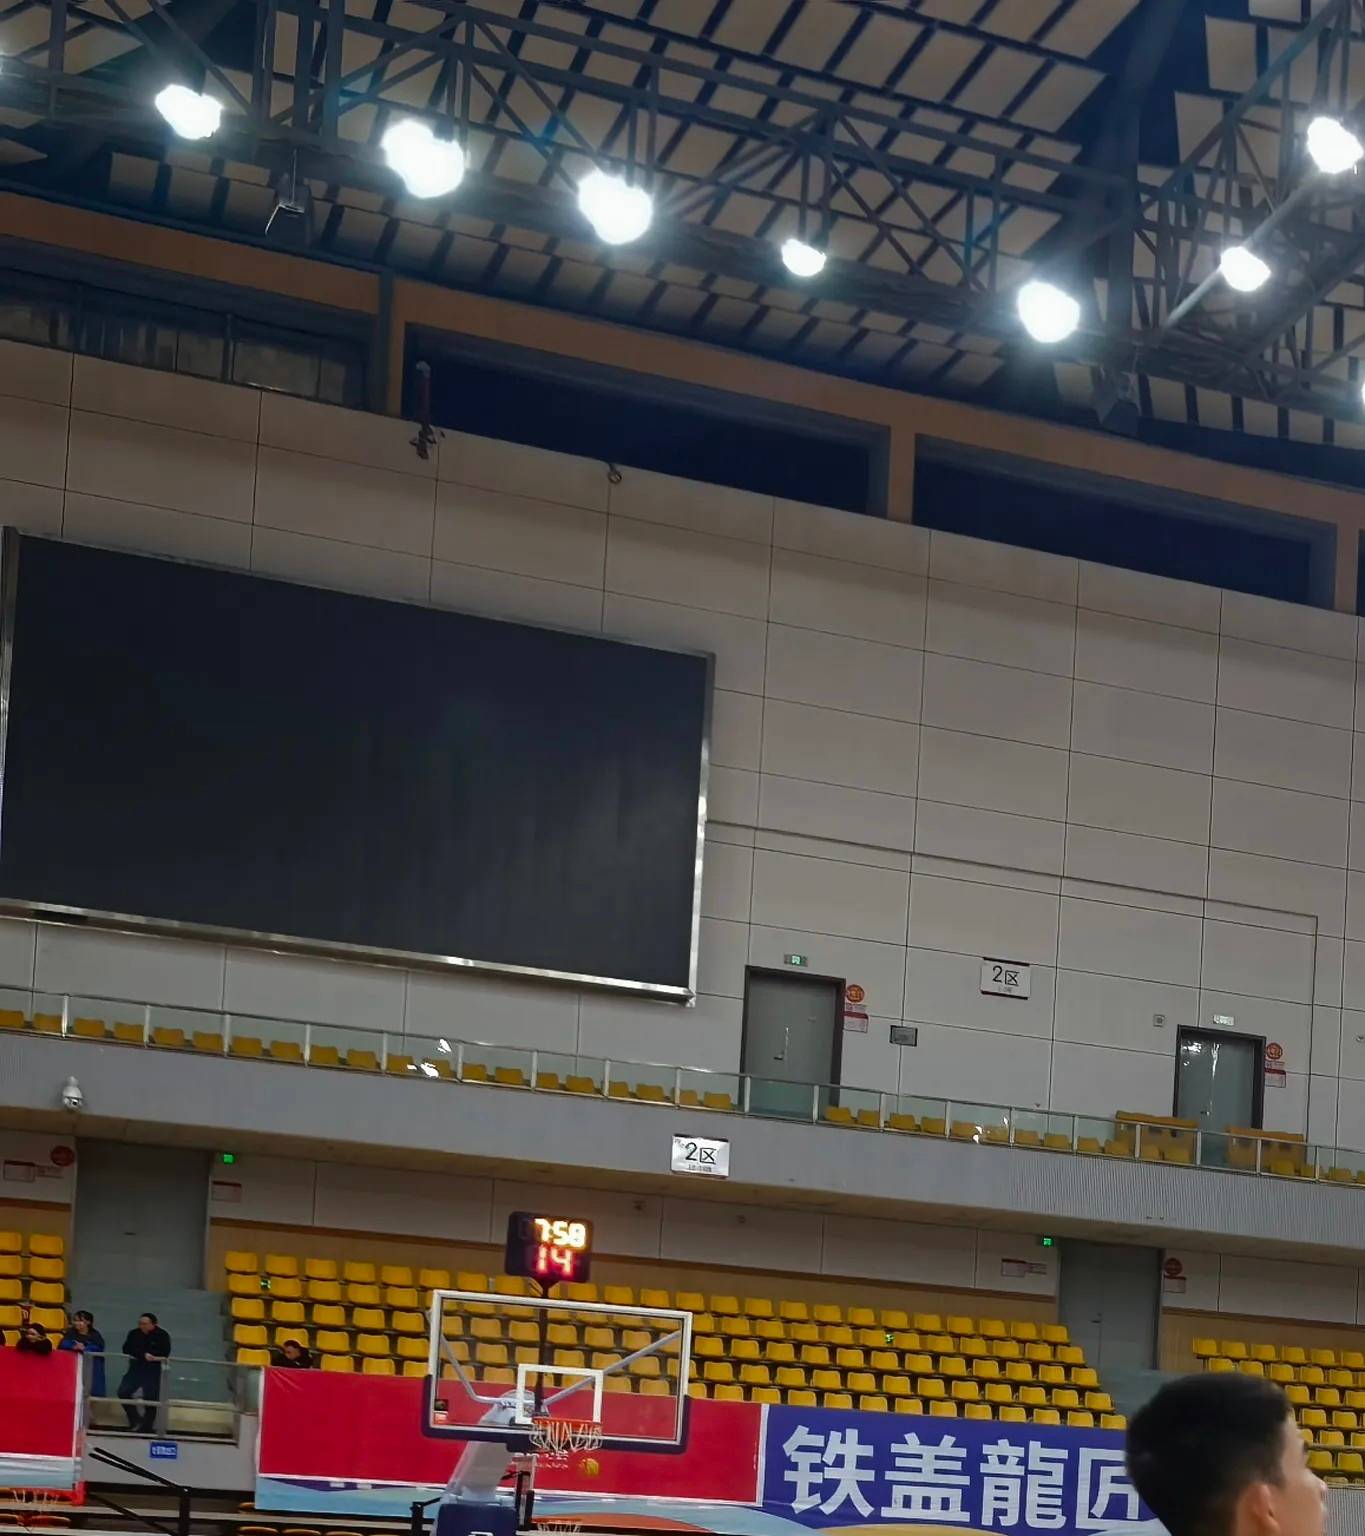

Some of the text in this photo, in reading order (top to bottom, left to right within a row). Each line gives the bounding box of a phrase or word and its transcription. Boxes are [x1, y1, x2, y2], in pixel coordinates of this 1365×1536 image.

[992, 965, 1020, 987] 2区
[684, 1141, 717, 1165] 2区
[533, 1217, 586, 1248] 7:58
[536, 1245, 573, 1276] 14
